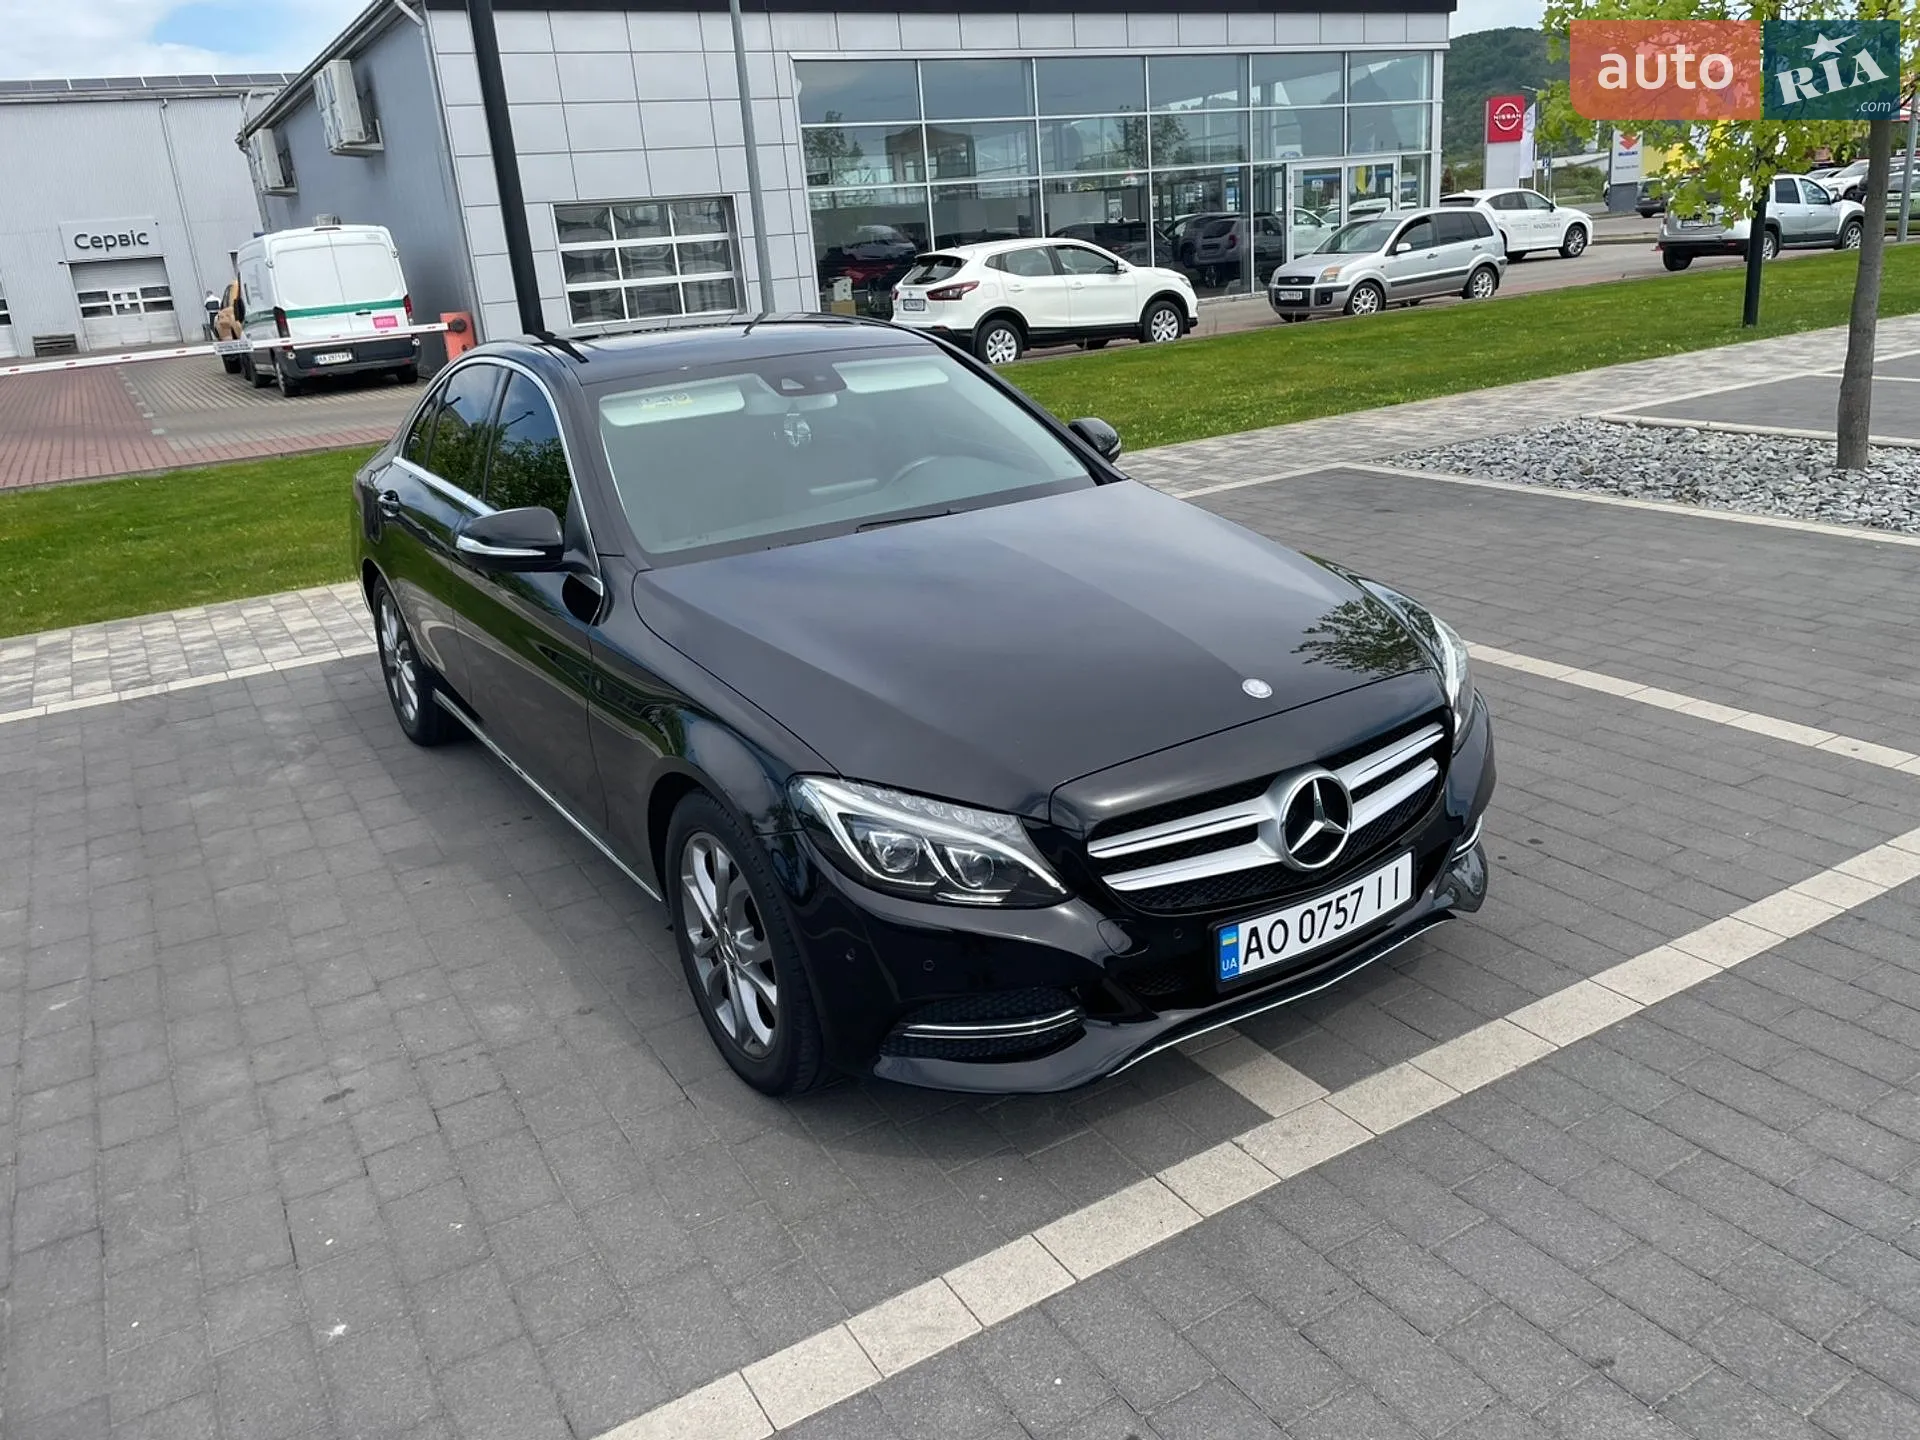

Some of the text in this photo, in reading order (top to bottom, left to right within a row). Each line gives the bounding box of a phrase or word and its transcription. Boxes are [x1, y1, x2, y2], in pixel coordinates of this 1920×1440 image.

[74, 229, 149, 252] Сервіс
[1243, 918, 1289, 965] AO
[1298, 886, 1364, 944] 0757
[1221, 957, 1238, 972] UA
